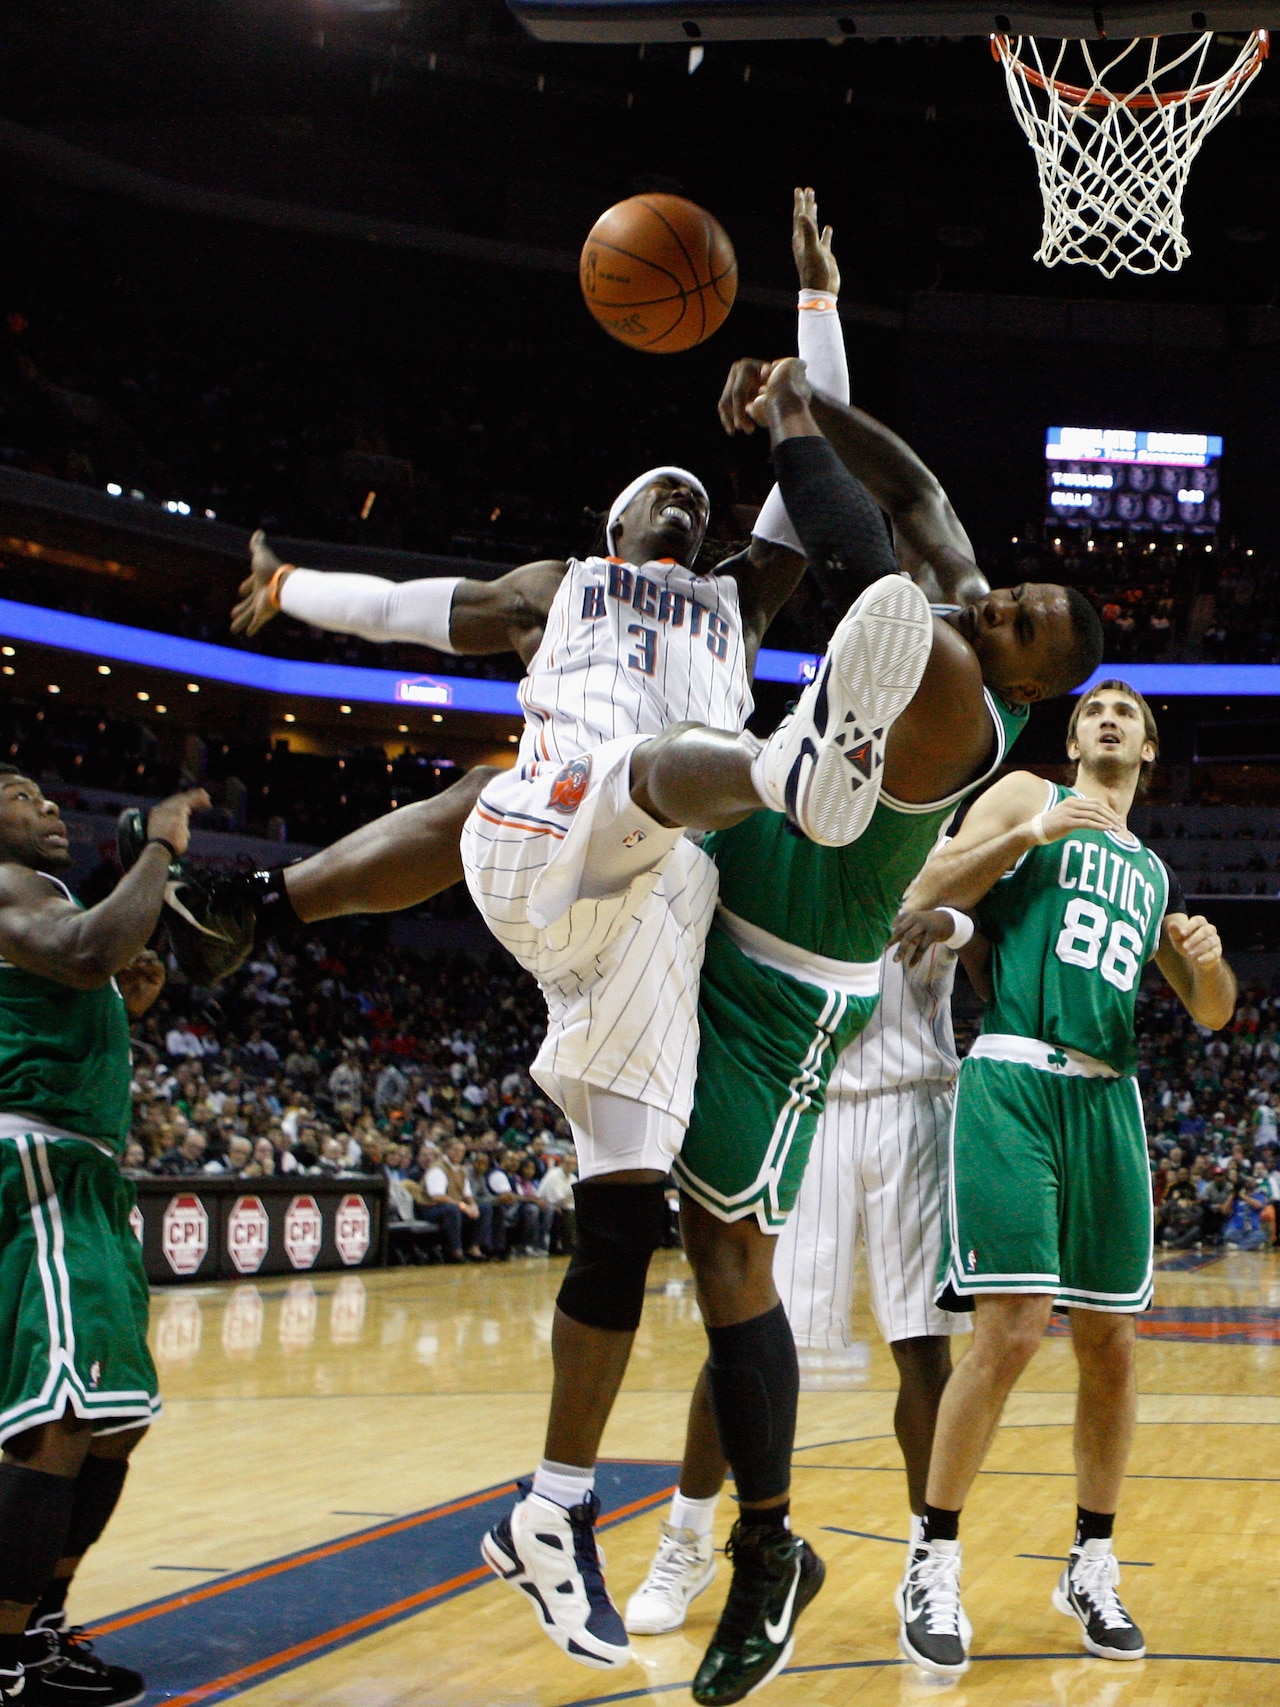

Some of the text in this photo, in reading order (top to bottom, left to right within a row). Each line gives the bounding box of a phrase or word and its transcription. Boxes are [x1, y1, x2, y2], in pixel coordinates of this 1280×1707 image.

[627, 623, 658, 678] 3
[1058, 839, 1155, 936] CELTICS
[1055, 897, 1144, 992] 86
[170, 1221, 202, 1244] CPI
[233, 1222, 263, 1244] CPI
[290, 1220, 317, 1241] CPI
[341, 1219, 365, 1239] CPI
